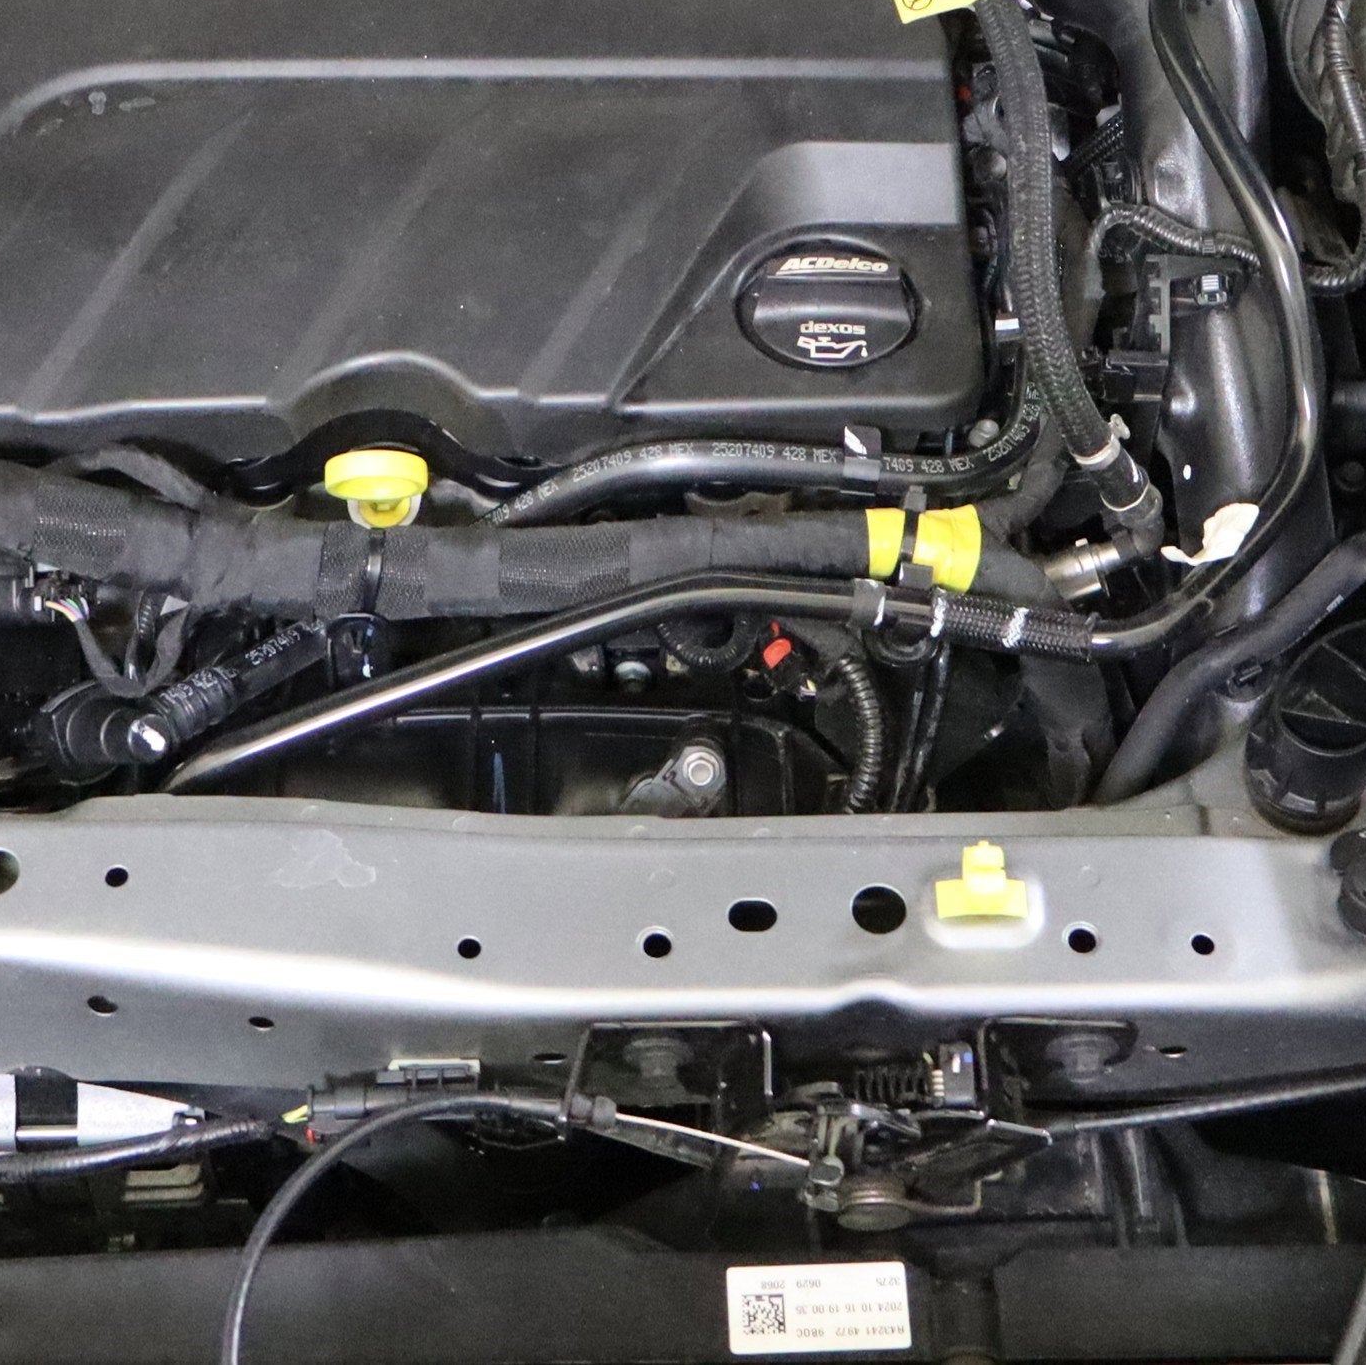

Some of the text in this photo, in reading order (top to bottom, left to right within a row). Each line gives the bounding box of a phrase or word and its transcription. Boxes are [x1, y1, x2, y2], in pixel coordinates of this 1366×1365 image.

[778, 257, 889, 274] ACDelco
[800, 320, 866, 335] dexos
[921, 459, 945, 474] 428
[513, 491, 534, 511] 428
[572, 450, 632, 483] 25207409
[669, 442, 694, 457] MEX
[712, 442, 775, 458] 25207409
[782, 446, 806, 461] 428
[813, 448, 836, 463] MEX
